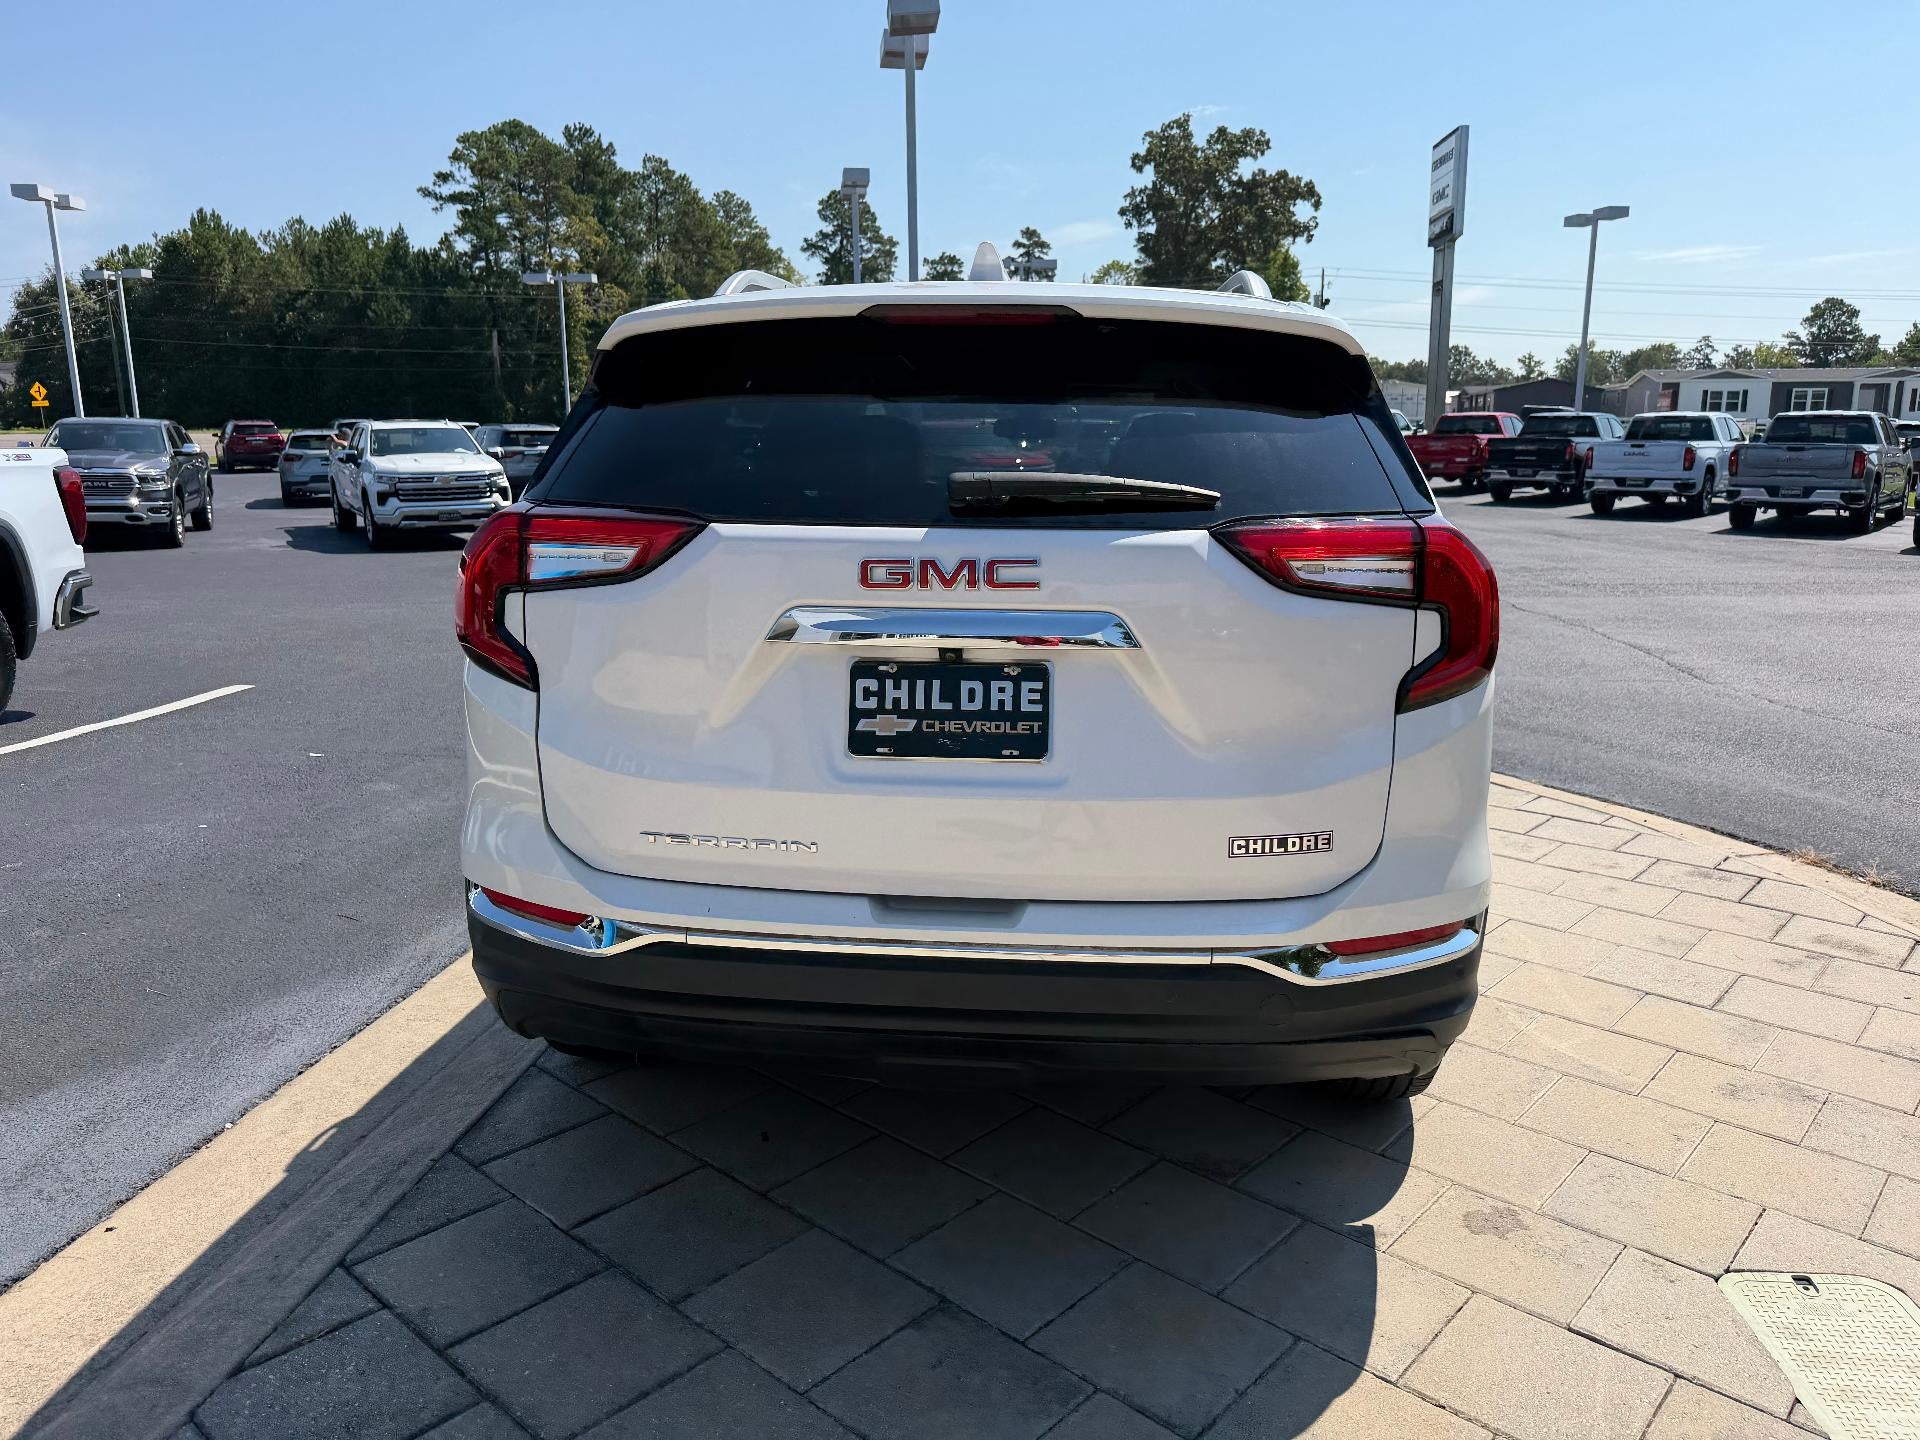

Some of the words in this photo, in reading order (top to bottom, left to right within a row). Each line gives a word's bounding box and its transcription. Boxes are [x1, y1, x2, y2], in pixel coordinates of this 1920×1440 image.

[858, 556, 1041, 591] GMC
[855, 678, 1044, 712] CHILDRE
[922, 720, 1042, 734] CHEVROLET
[639, 830, 818, 854] TERRAIN
[1232, 834, 1331, 855] CHILDRE
